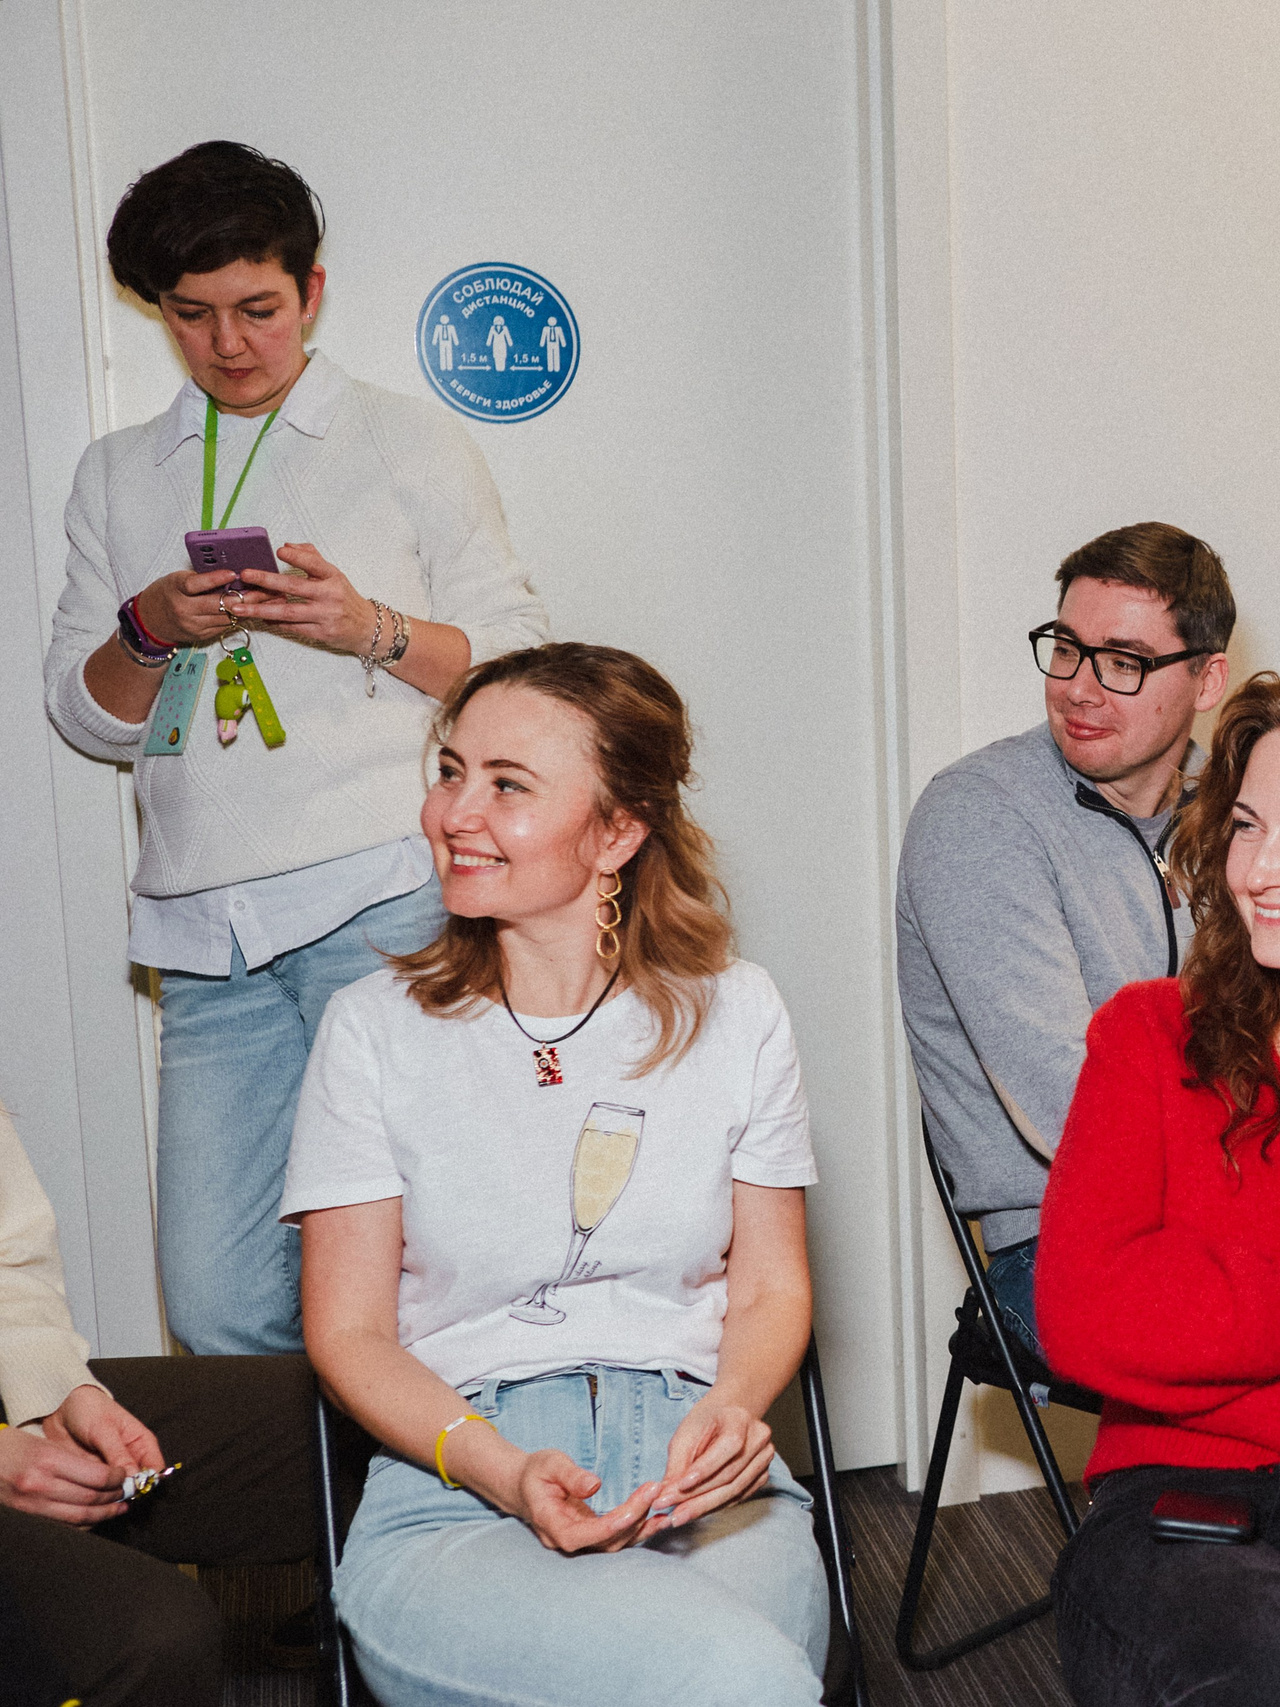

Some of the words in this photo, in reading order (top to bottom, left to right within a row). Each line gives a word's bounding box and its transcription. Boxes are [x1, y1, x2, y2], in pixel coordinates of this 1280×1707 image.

[453, 277, 544, 306] СОБЛЮДАЙ
[461, 295, 535, 319] ДИСТАНЦИЮ
[460, 353, 476, 363] 1,5
[513, 353, 528, 364] 1,5
[450, 378, 491, 408] БЕРЕГИ
[495, 379, 552, 411] ЗДОРОВЬЕ
